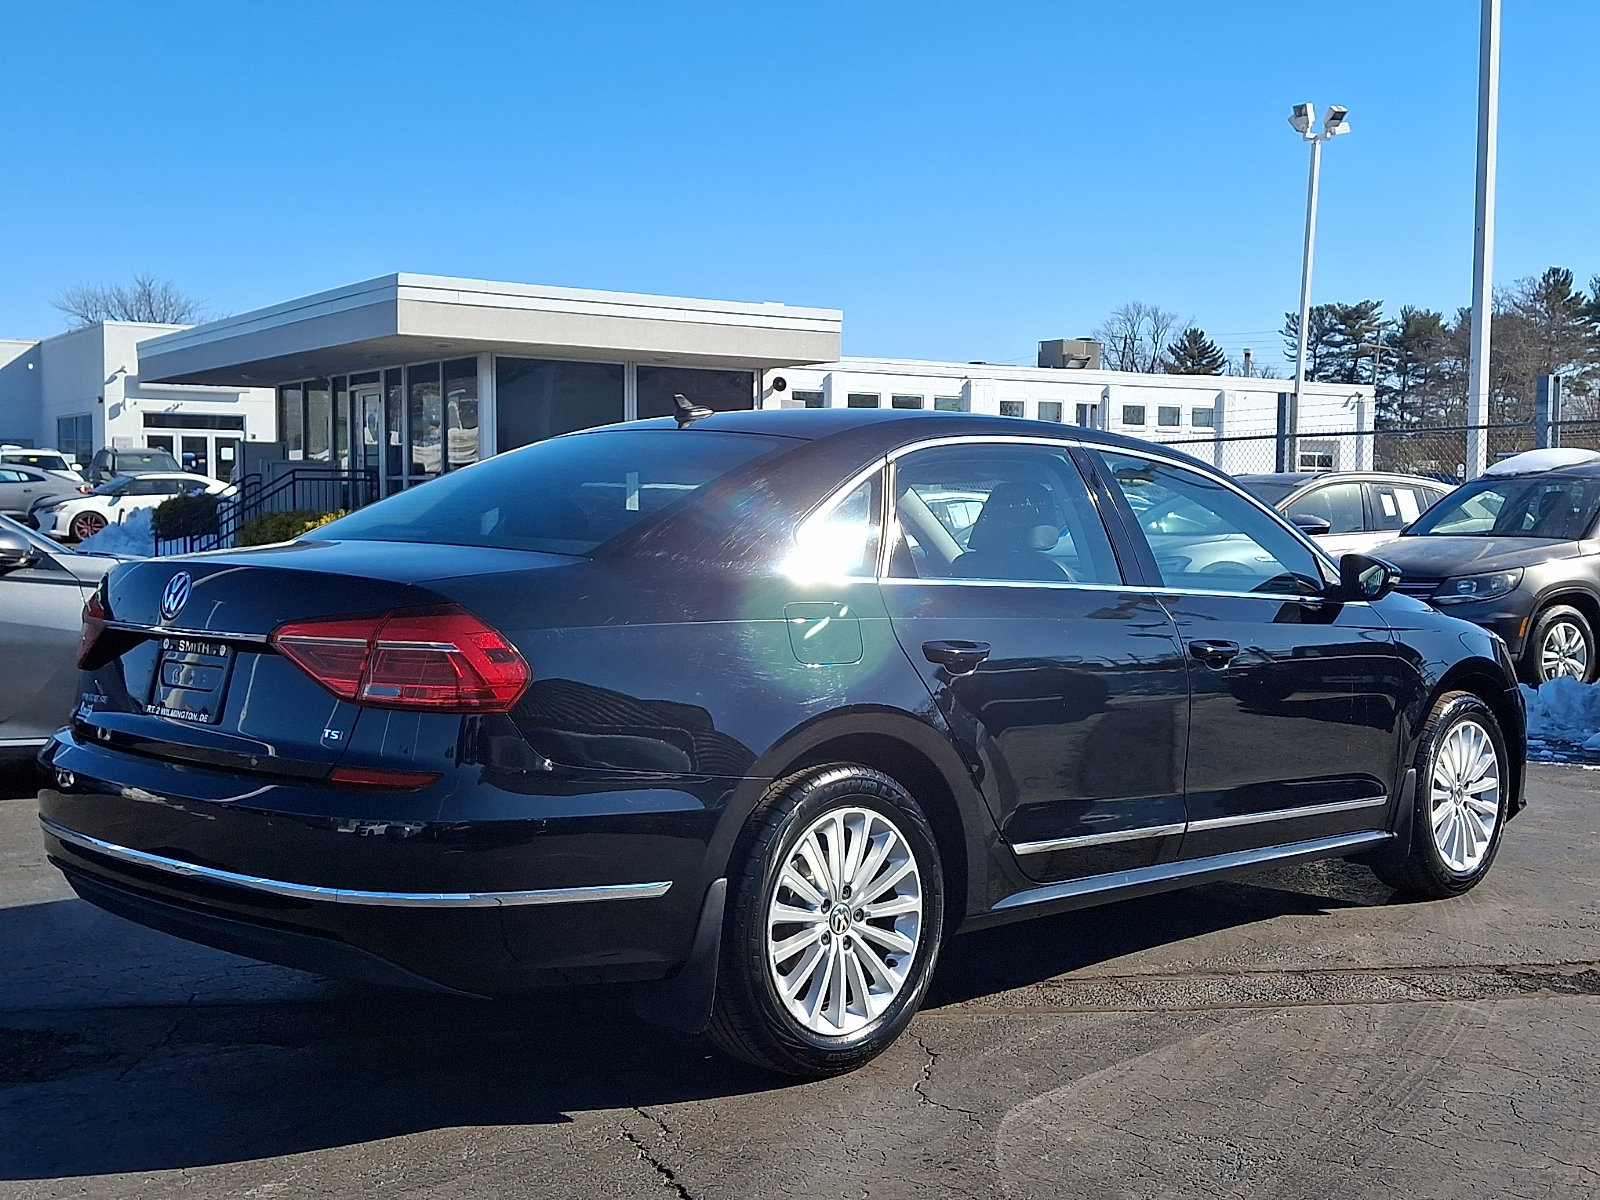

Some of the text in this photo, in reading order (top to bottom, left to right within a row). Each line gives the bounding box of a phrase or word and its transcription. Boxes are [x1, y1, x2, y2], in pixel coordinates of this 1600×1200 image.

[163, 571, 191, 618] VW
[178, 640, 210, 655] SMITH
[199, 713, 209, 723] DE
